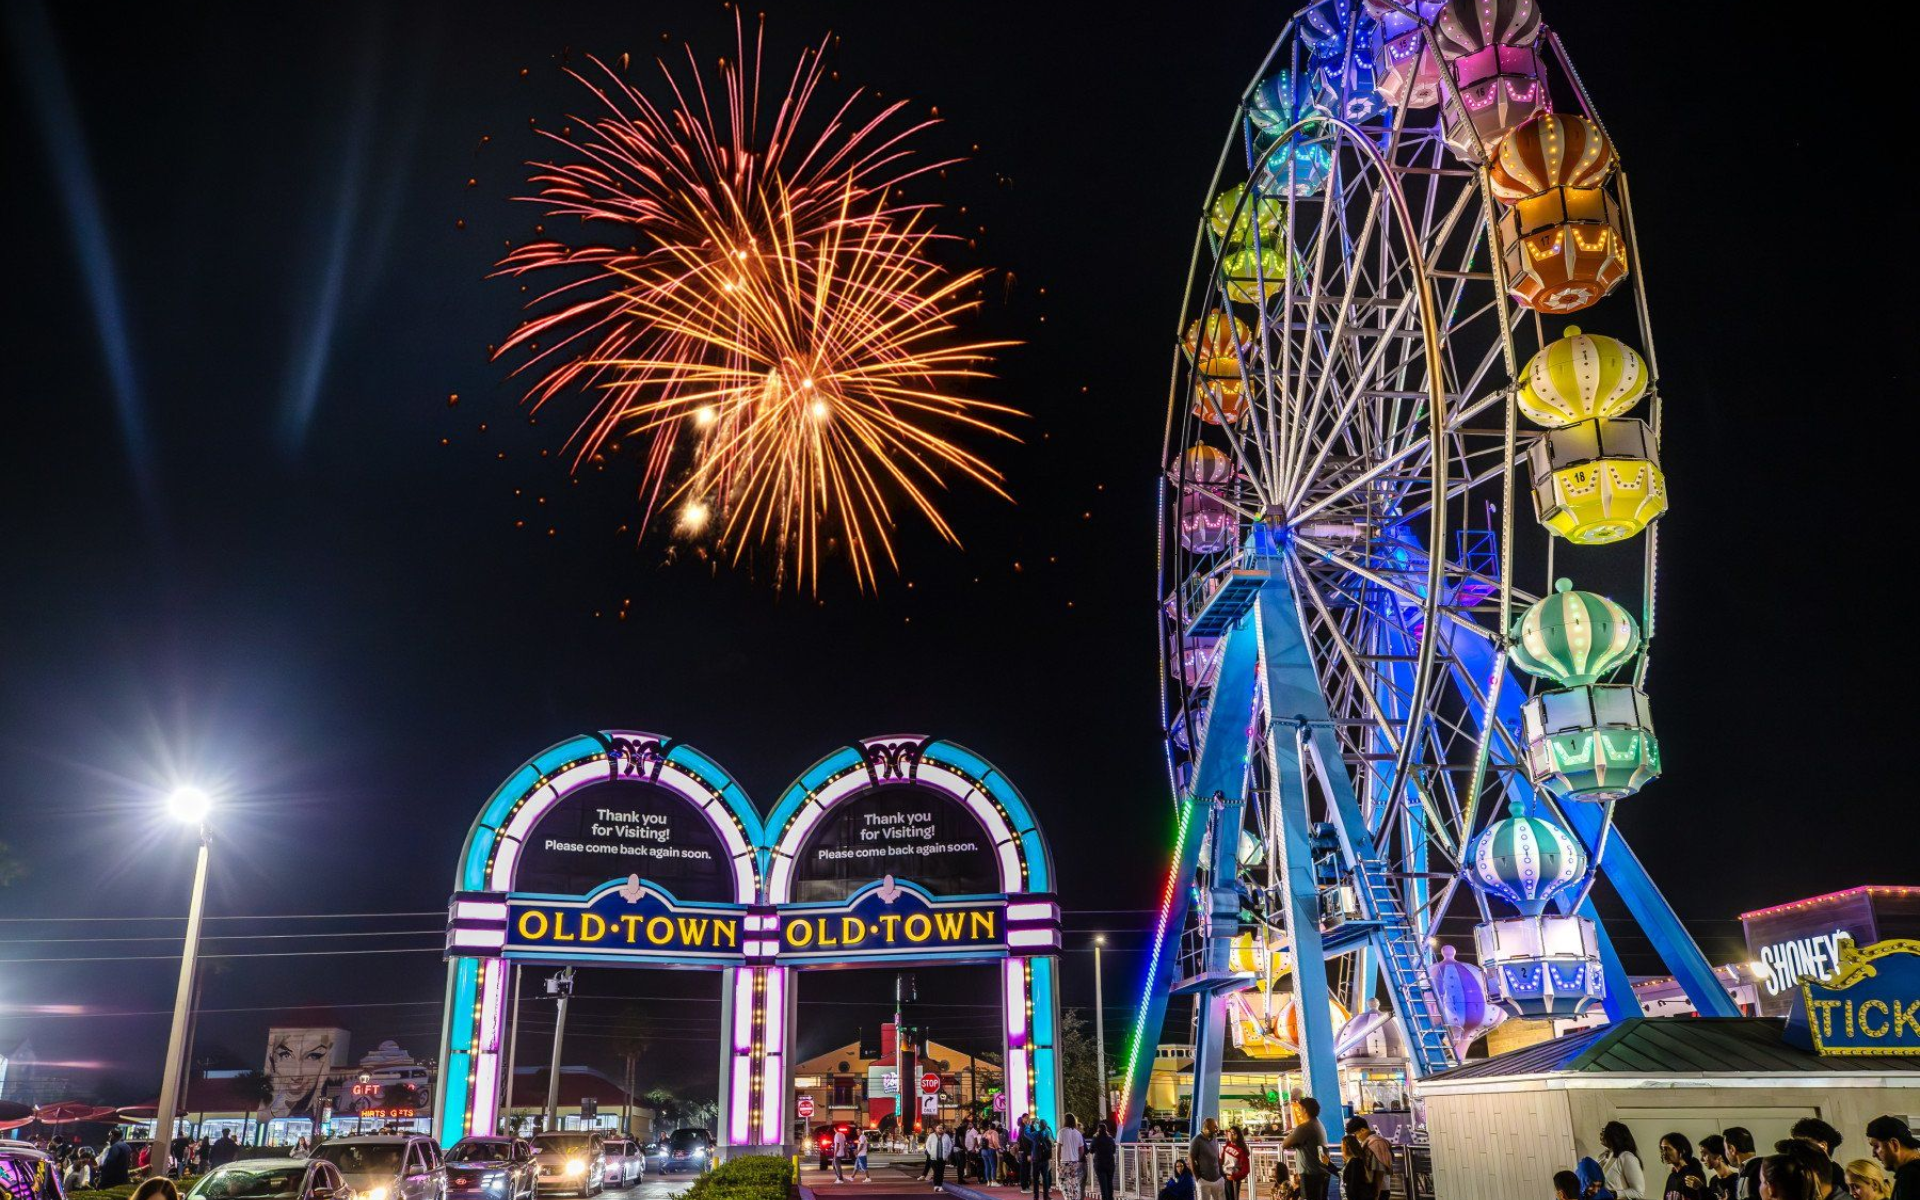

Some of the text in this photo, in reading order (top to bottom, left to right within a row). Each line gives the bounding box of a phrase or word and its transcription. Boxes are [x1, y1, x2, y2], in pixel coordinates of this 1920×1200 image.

[1541, 235, 1550, 246] 17
[1574, 471, 1586, 483] 18
[1571, 740, 1576, 750] 1
[597, 808, 667, 828] Thank you
[864, 811, 932, 825] Thank you
[591, 823, 670, 843] for Visiting!
[860, 825, 935, 841] for Visiting!
[545, 840, 712, 860] Please come back again soon.
[818, 841, 978, 860] Please come back again soon.
[1761, 929, 1851, 996] SHONEY'
[1521, 967, 1527, 978] 2
[1814, 999, 1920, 1038] TICK
[922, 1080, 938, 1088] STOP
